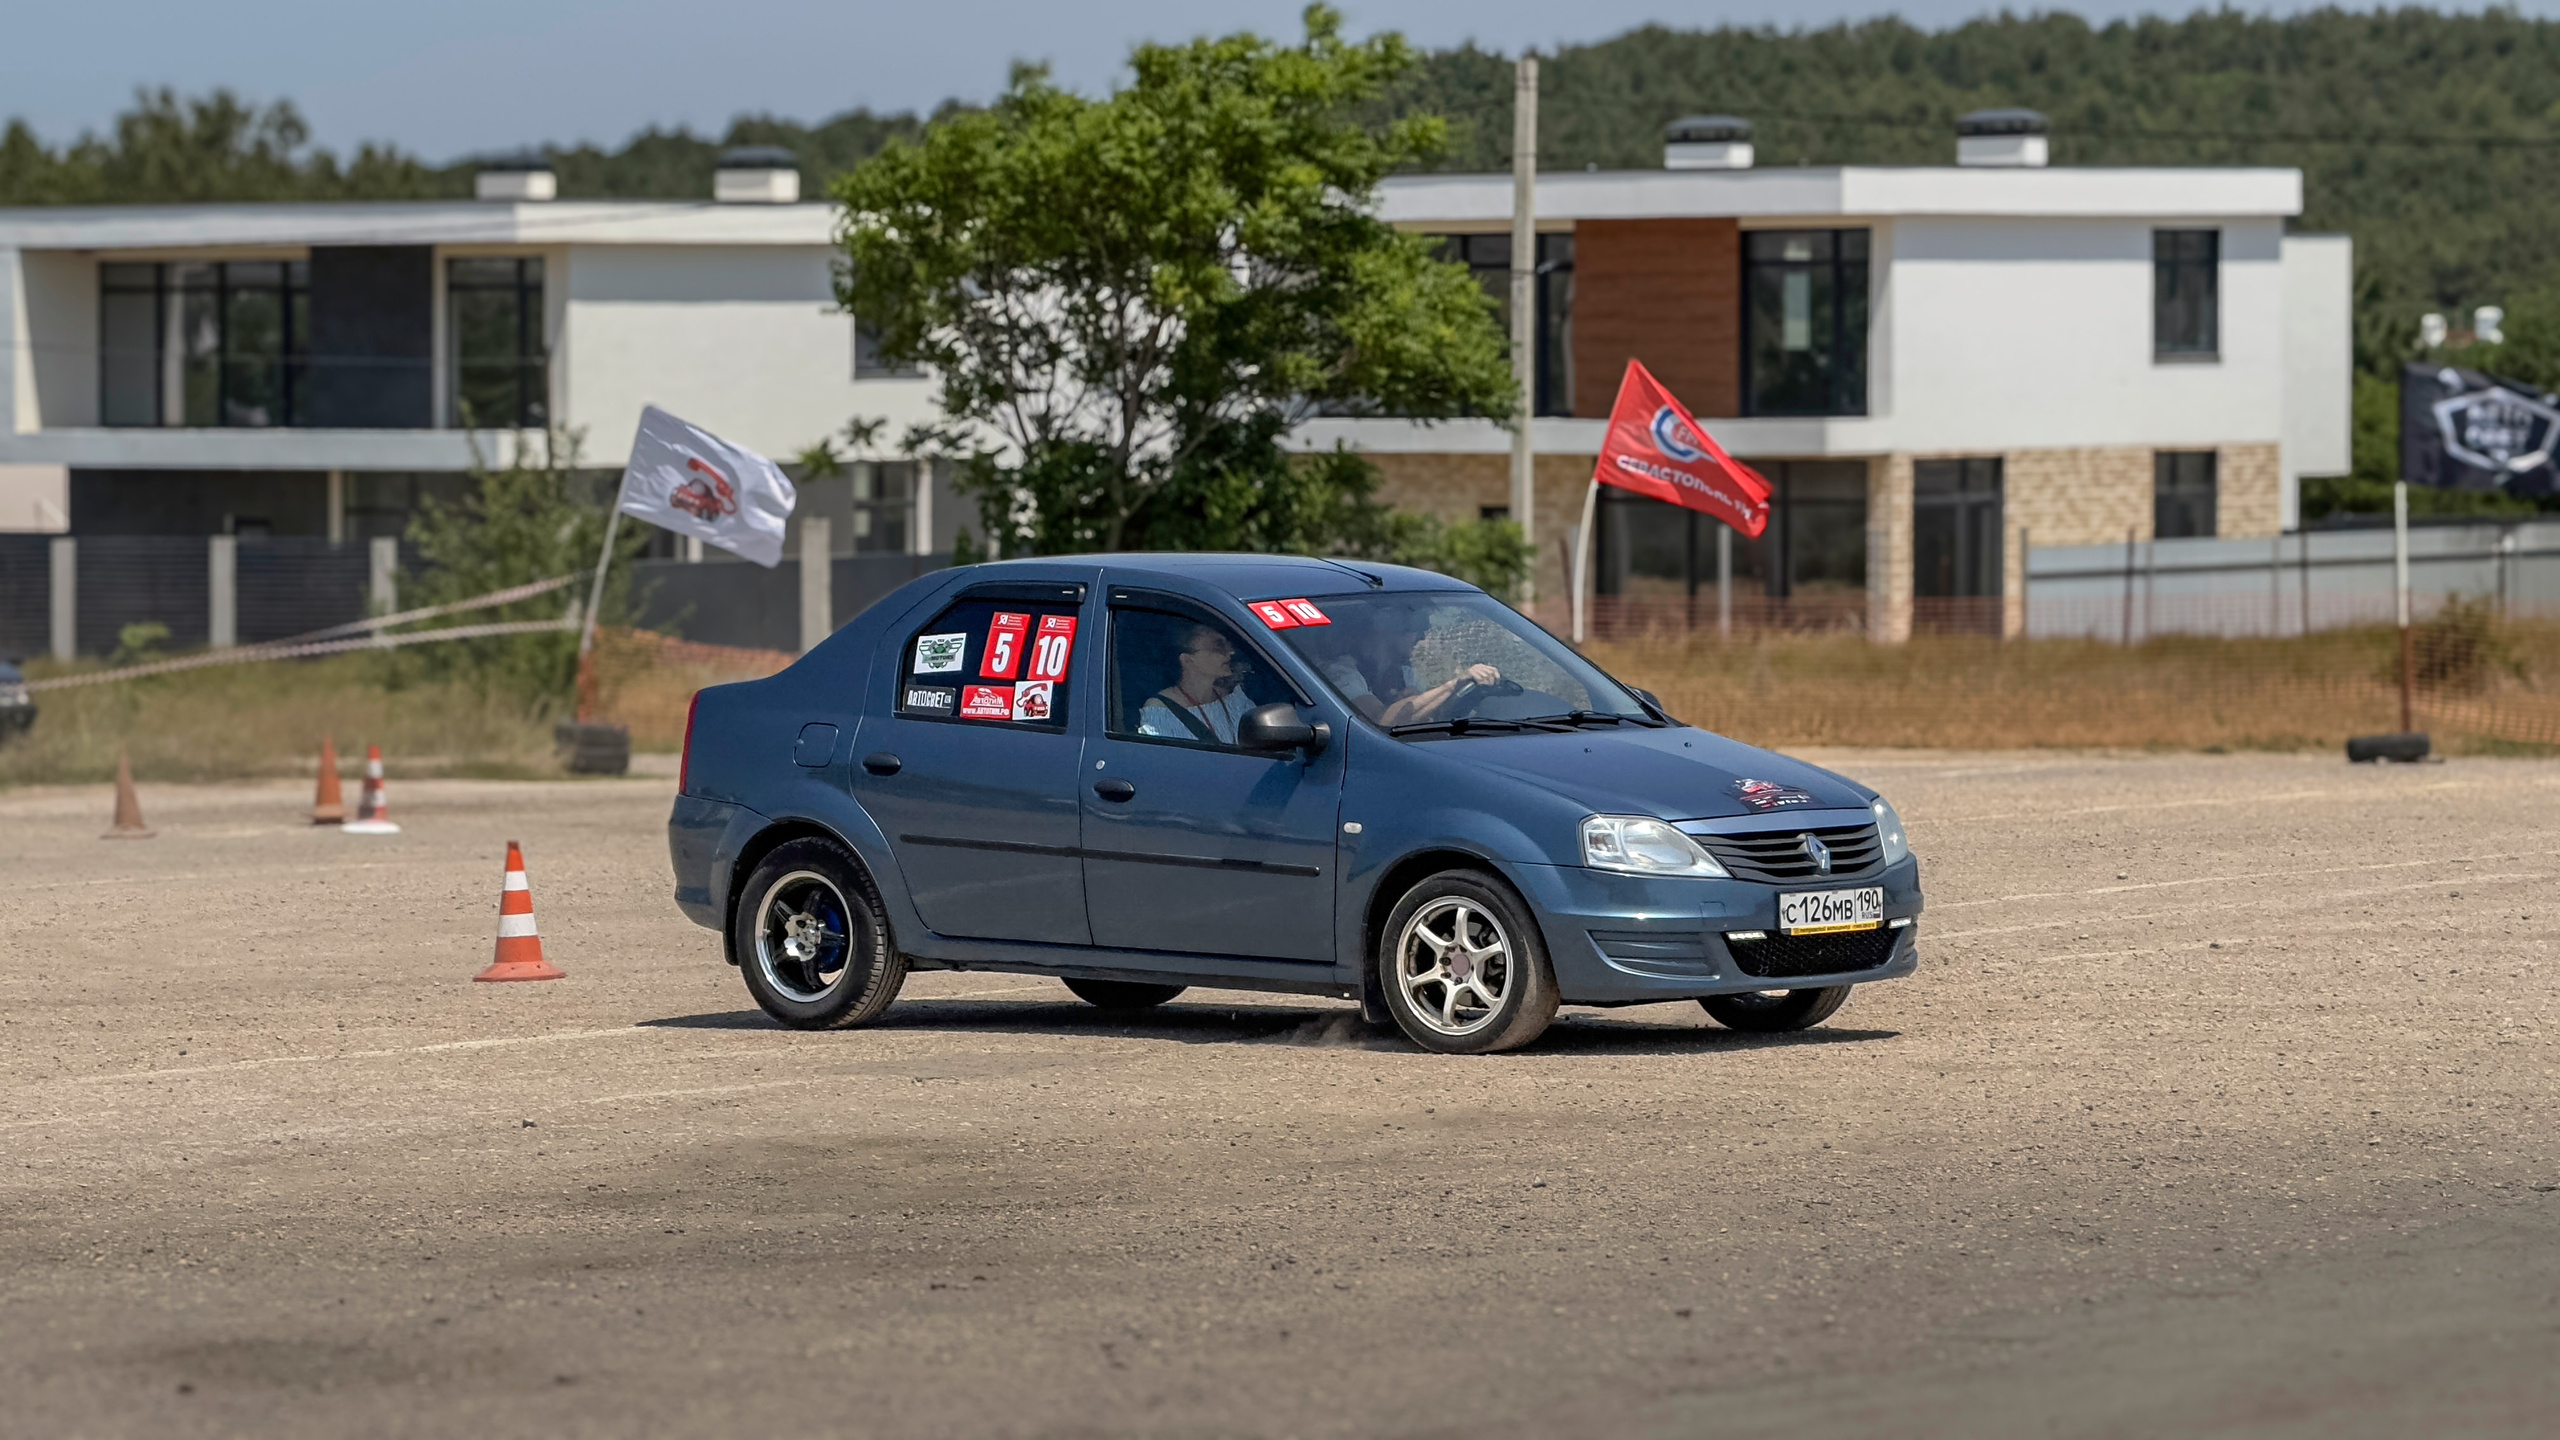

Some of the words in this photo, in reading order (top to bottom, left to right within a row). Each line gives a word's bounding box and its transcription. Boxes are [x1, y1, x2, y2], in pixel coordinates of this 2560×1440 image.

[1260, 606, 1284, 622] 5
[1288, 603, 1321, 619] 10
[992, 632, 1014, 673] 5
[1036, 635, 1067, 677] 10
[1857, 890, 1878, 911] 190
[1862, 911, 1873, 919] RUS
